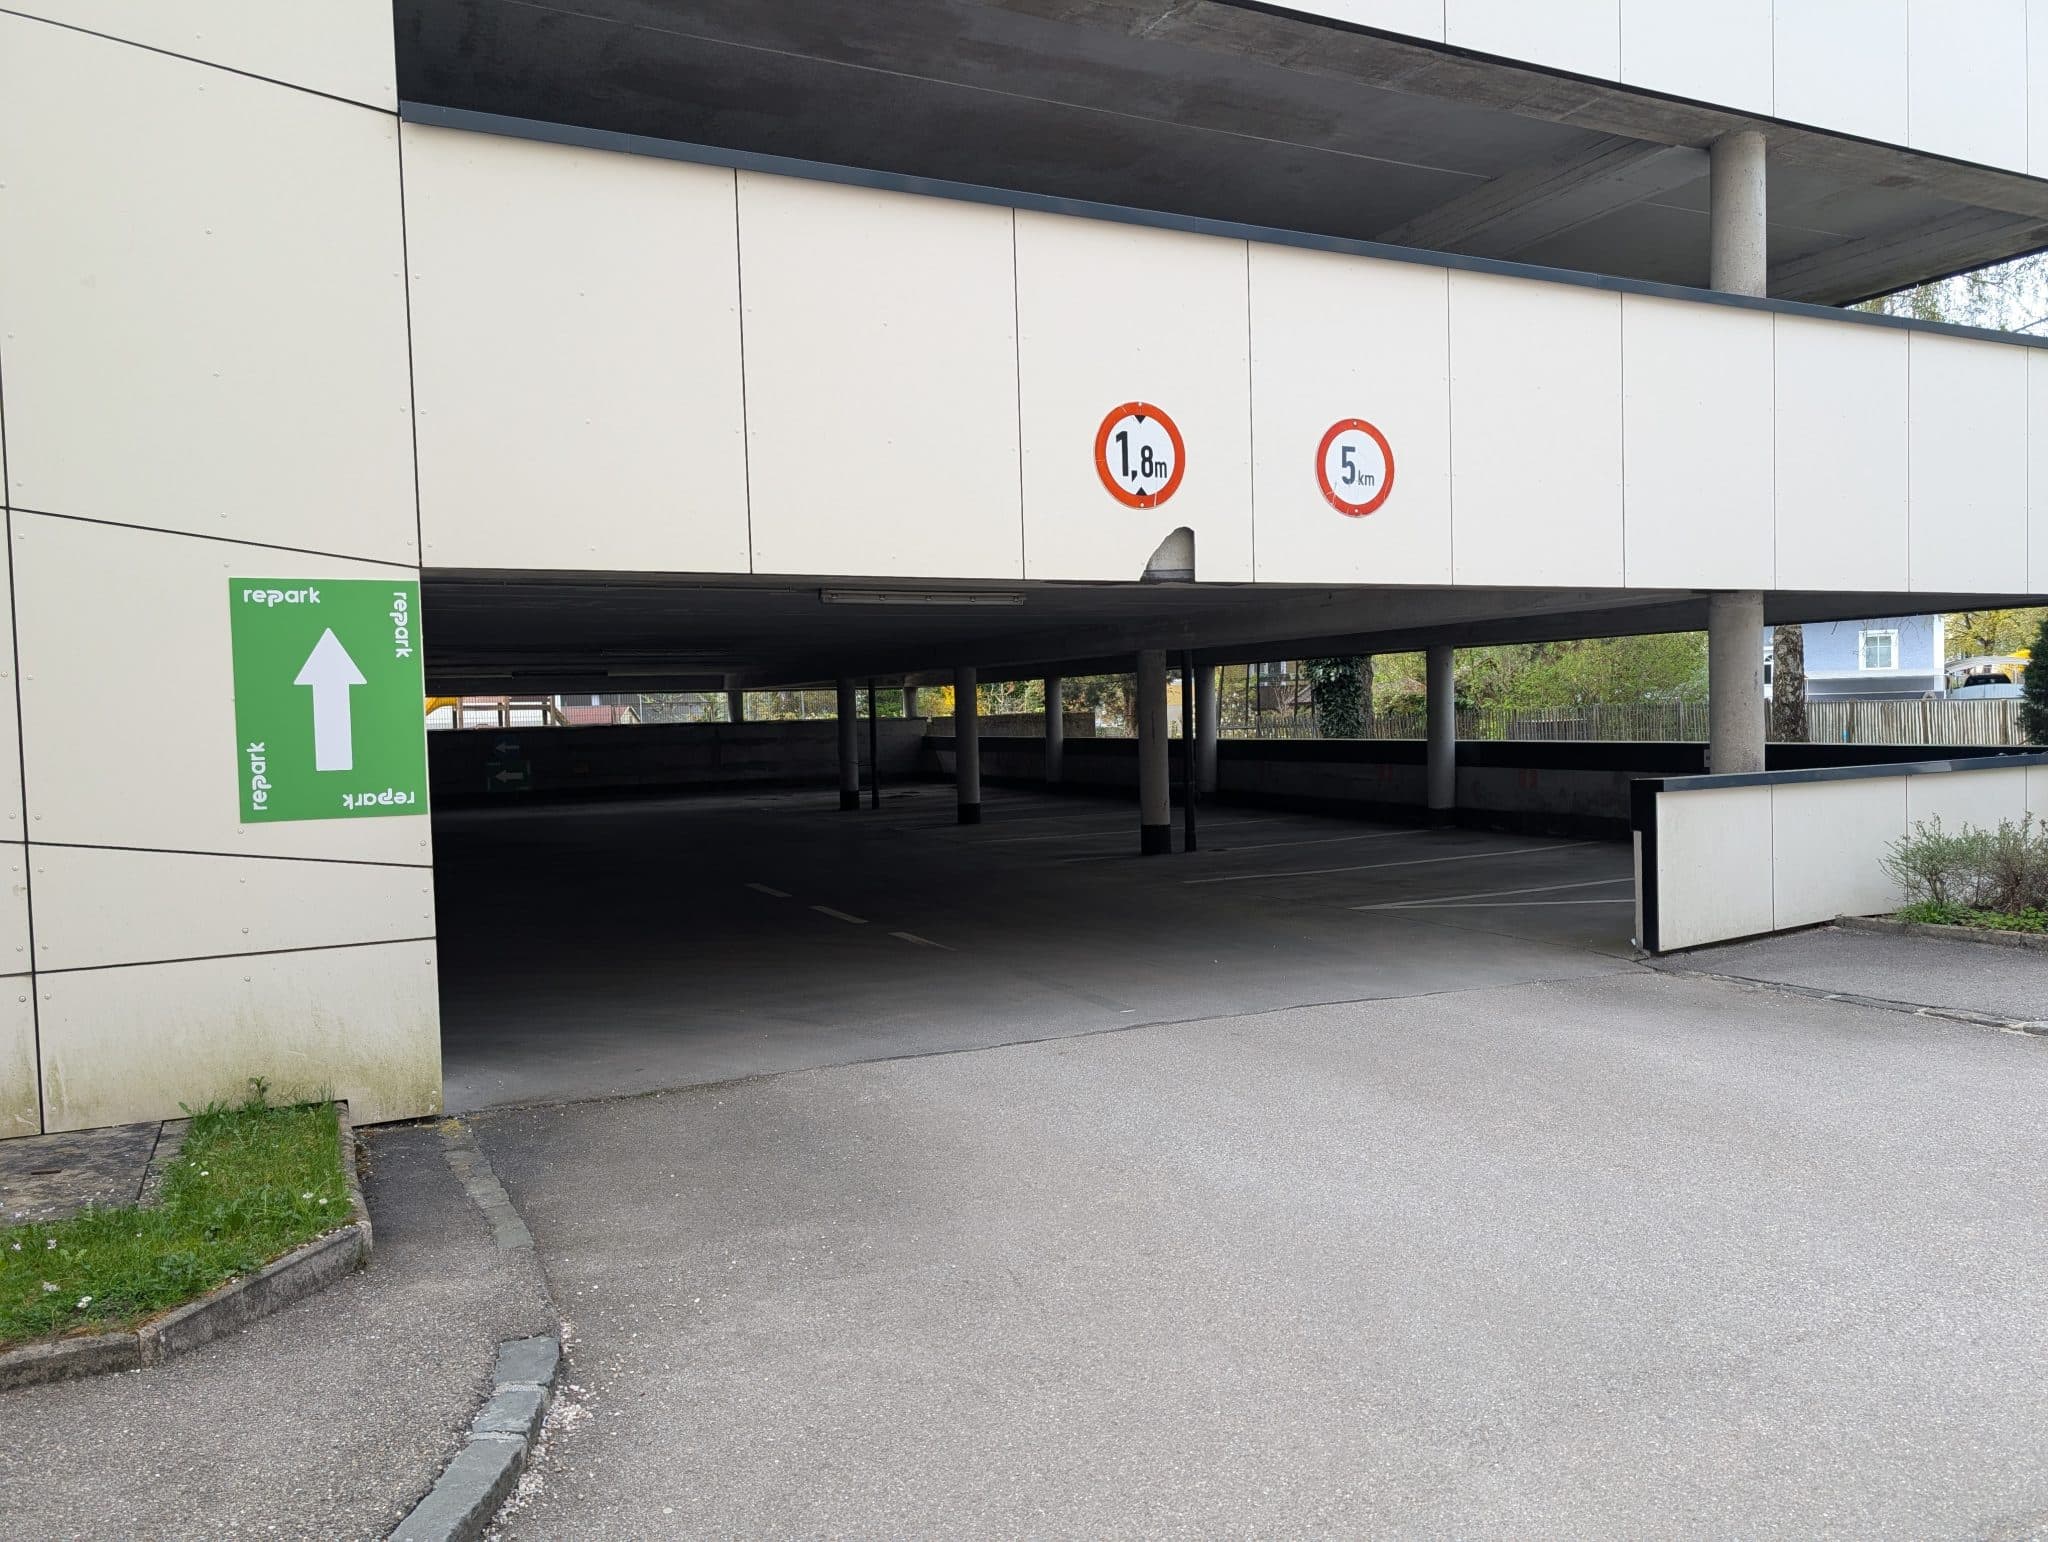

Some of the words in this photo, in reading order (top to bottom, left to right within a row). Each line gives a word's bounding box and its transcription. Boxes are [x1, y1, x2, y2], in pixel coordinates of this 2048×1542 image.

[243, 586, 321, 608] repark
[389, 592, 413, 658] repark
[246, 742, 272, 811] repark
[342, 787, 415, 810] repark
